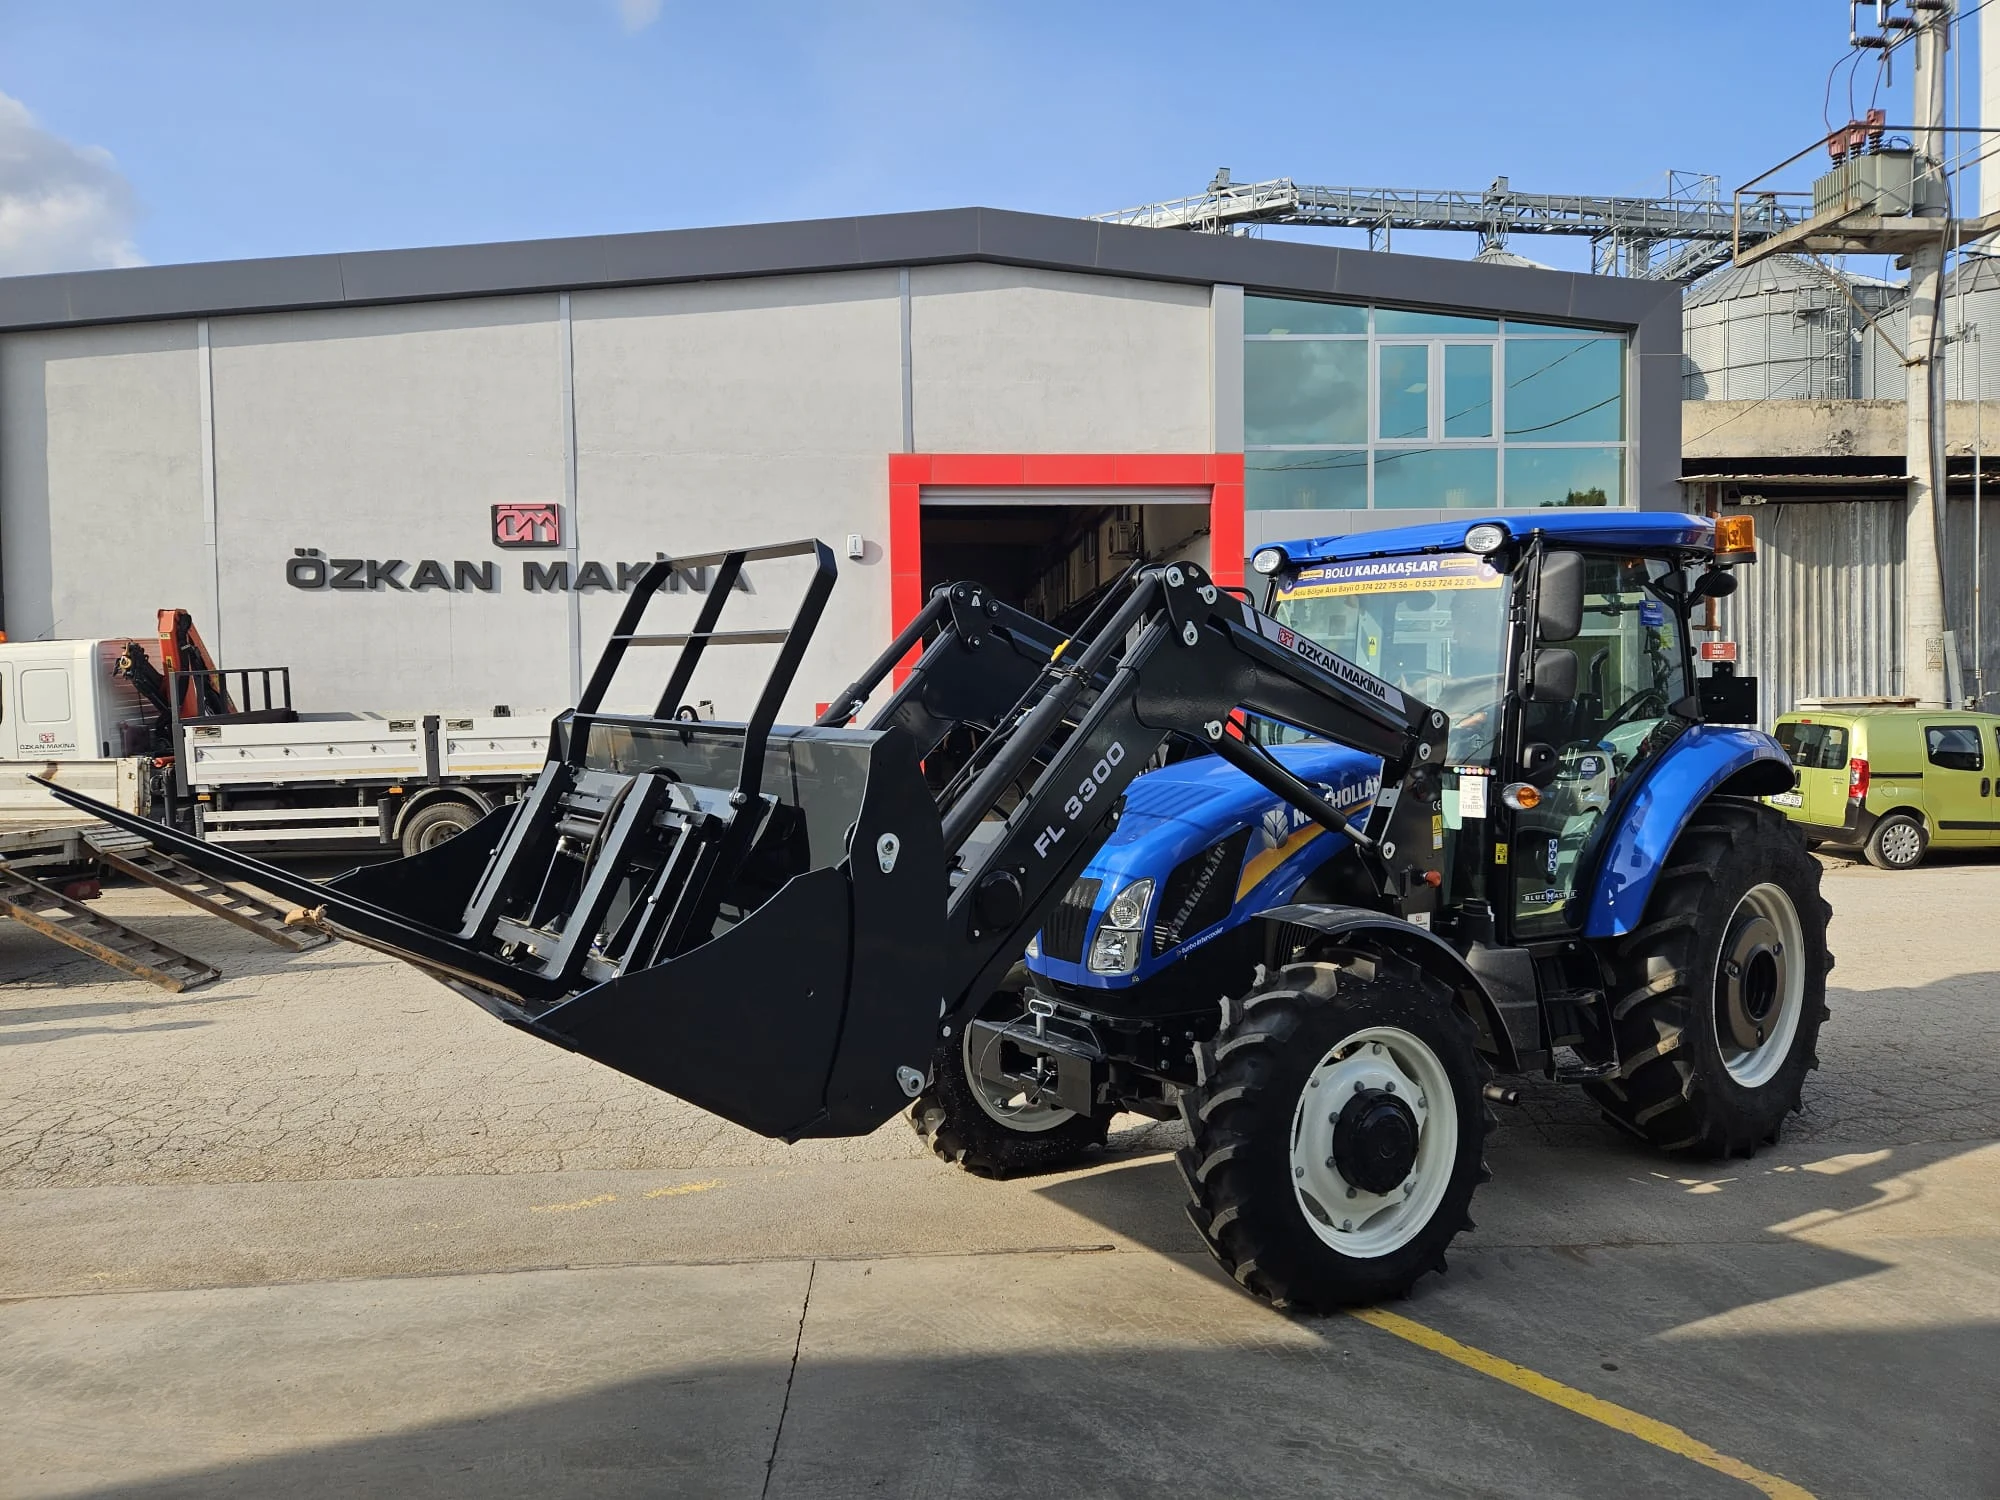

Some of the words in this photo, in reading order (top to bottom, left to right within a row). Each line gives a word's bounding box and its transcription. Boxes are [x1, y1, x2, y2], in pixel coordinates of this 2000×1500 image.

[286, 548, 493, 590] ÖZKAN
[1325, 566, 1352, 579] BOLU
[1354, 560, 1438, 577] KARAKAŞLAR
[1361, 583, 1372, 591] 374
[1298, 640, 1340, 674] ÖZKAN
[1341, 666, 1386, 700] MAKİNA
[1033, 825, 1066, 859] FL
[1064, 741, 1125, 820] 3300
[1331, 775, 1382, 809] HOLLAN
